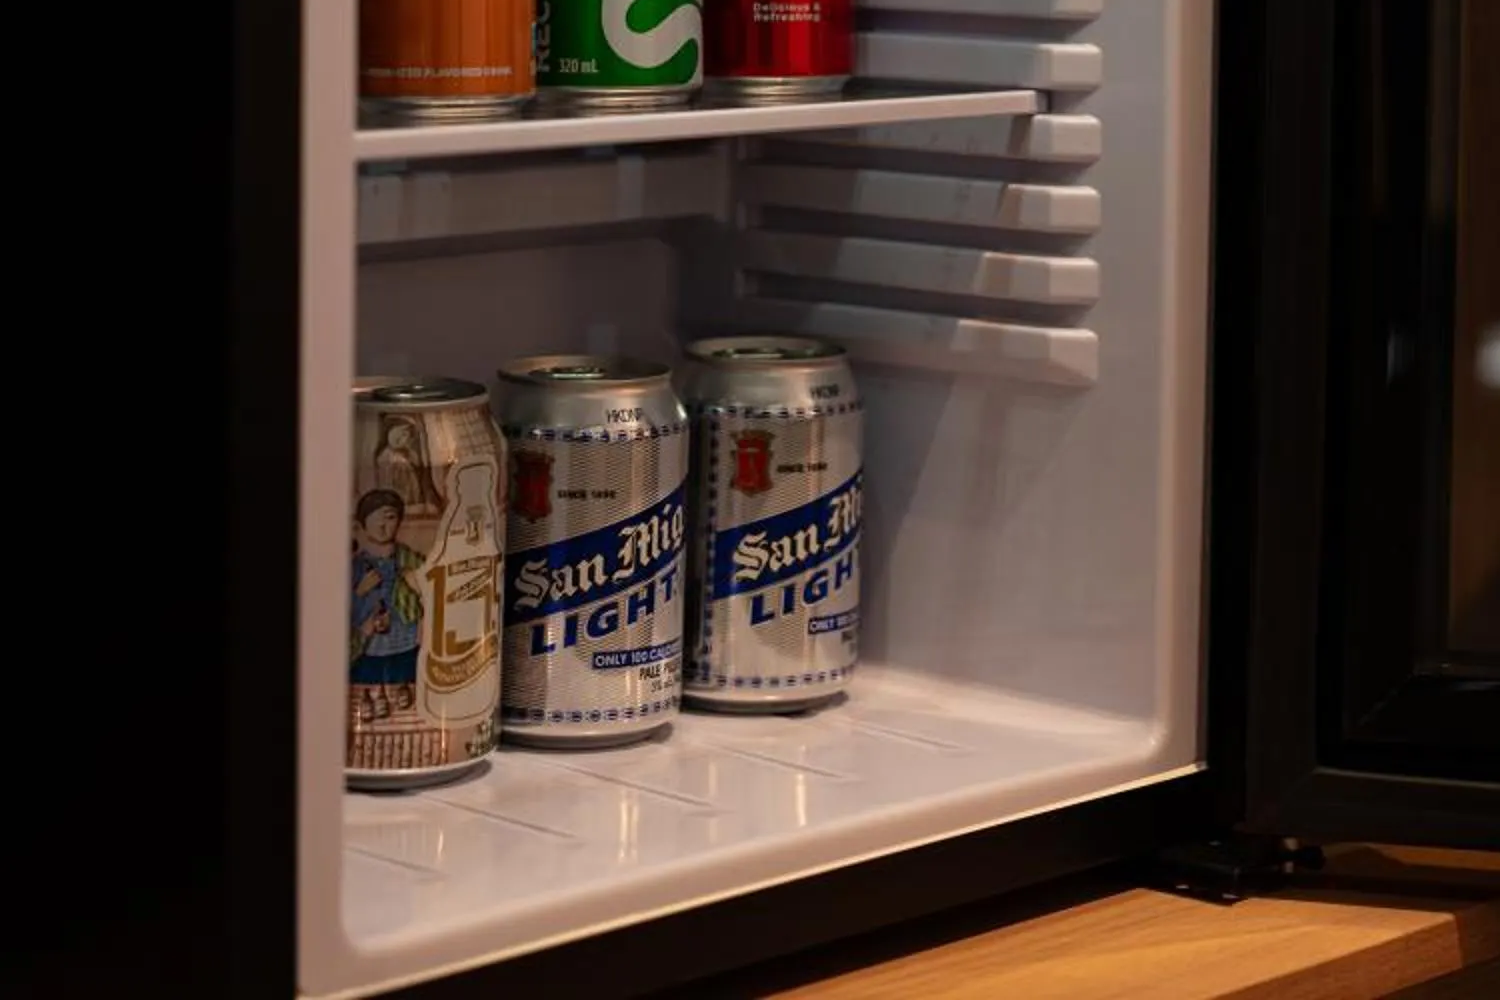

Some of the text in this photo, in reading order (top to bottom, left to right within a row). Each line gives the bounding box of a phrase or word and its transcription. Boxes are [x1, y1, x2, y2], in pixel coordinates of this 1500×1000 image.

[559, 58, 579, 73] 320
[732, 523, 822, 581] San
[512, 554, 609, 612] San
[532, 566, 677, 656] LIGHT
[595, 653, 628, 667] ONLY
